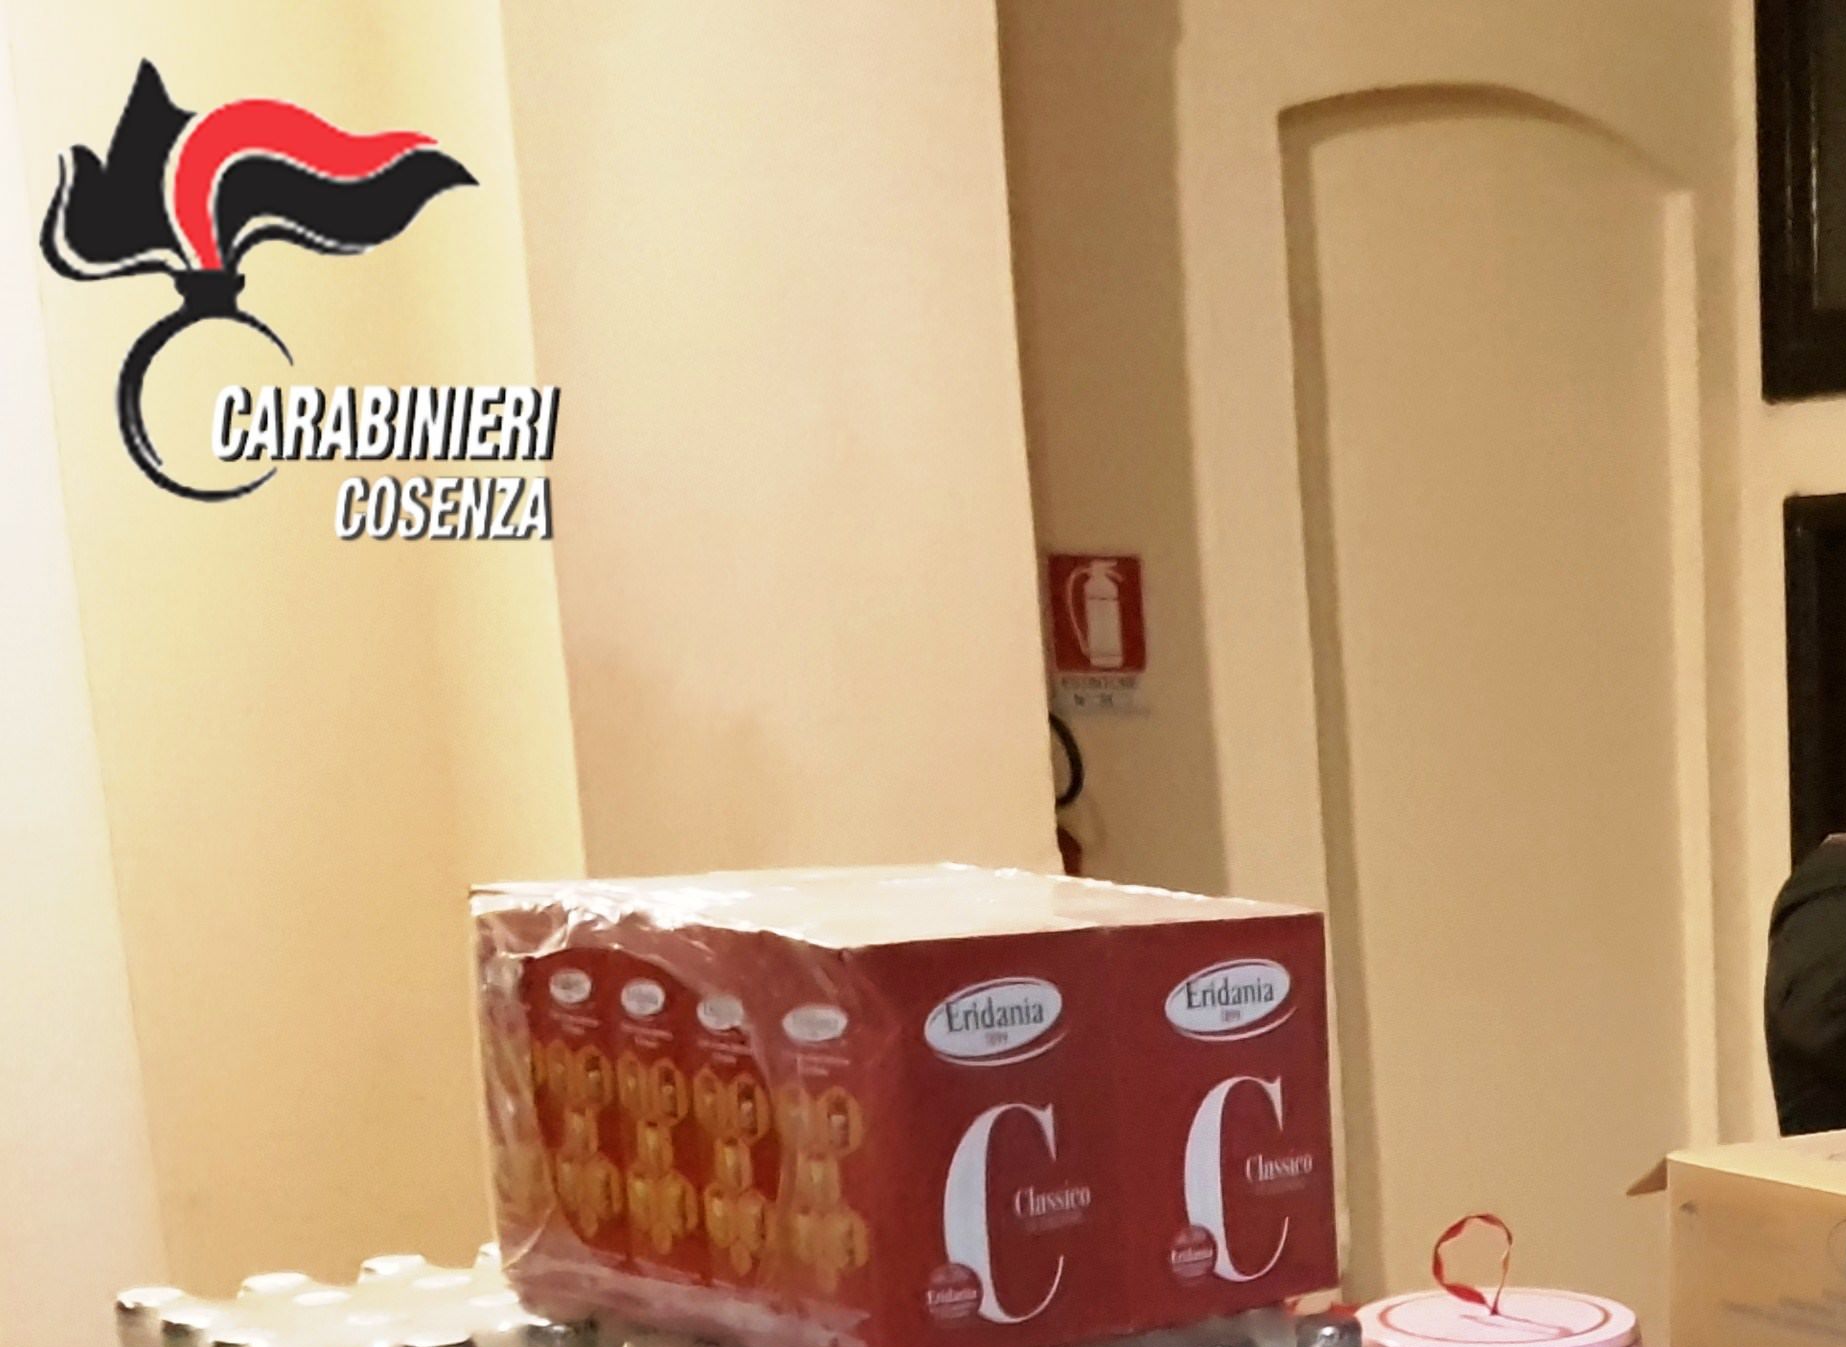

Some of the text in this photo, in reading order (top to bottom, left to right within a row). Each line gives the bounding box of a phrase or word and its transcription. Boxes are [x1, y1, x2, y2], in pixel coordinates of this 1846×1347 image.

[1185, 976, 1274, 1009] Eridania
[945, 996, 1044, 1033] Eridania
[1246, 1150, 1313, 1182] Classico
[1015, 1180, 1092, 1217] Classico
